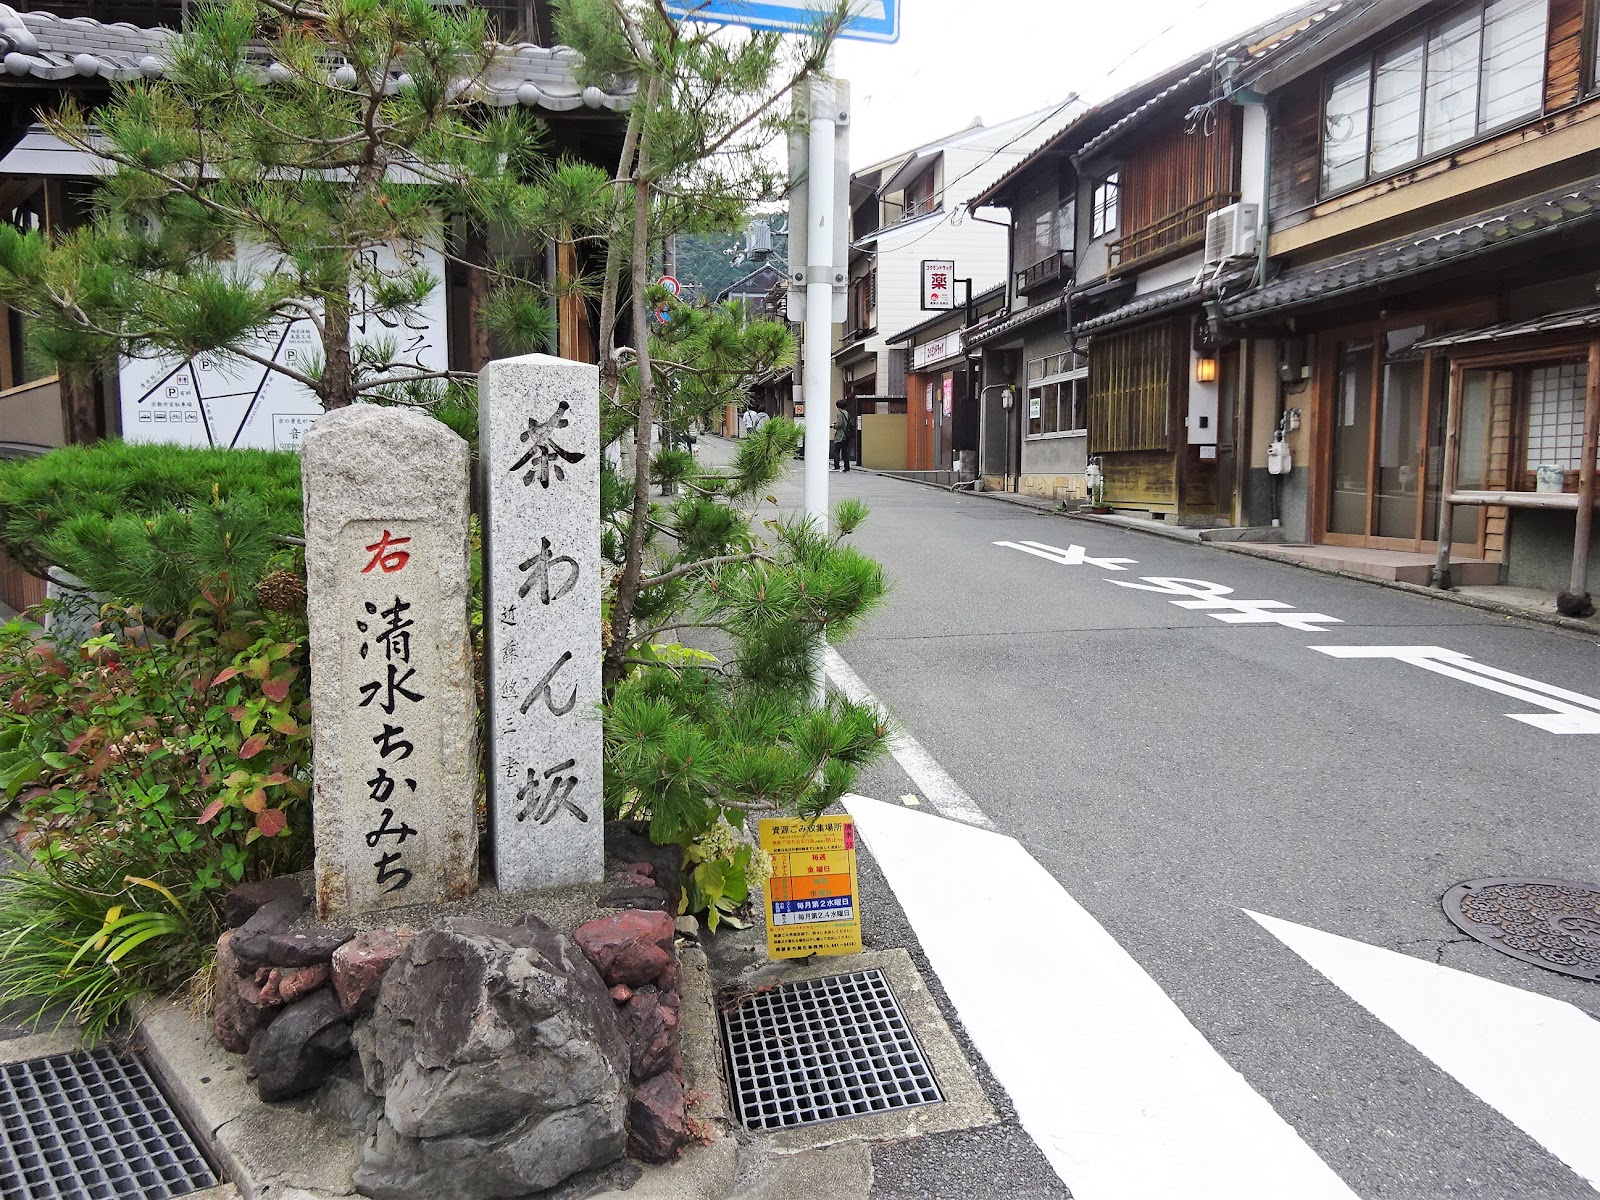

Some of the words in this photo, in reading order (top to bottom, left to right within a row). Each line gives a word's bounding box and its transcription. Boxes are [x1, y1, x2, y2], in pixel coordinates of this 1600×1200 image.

[931, 273, 947, 290] 薬
[361, 529, 411, 575] 右
[510, 400, 588, 826] 茶わん坂
[357, 595, 426, 895] 清水ちかみち
[807, 865, 831, 874] 金曜日
[809, 889, 832, 898] 水曜日
[796, 898, 849, 910] 毎月第2水曜日
